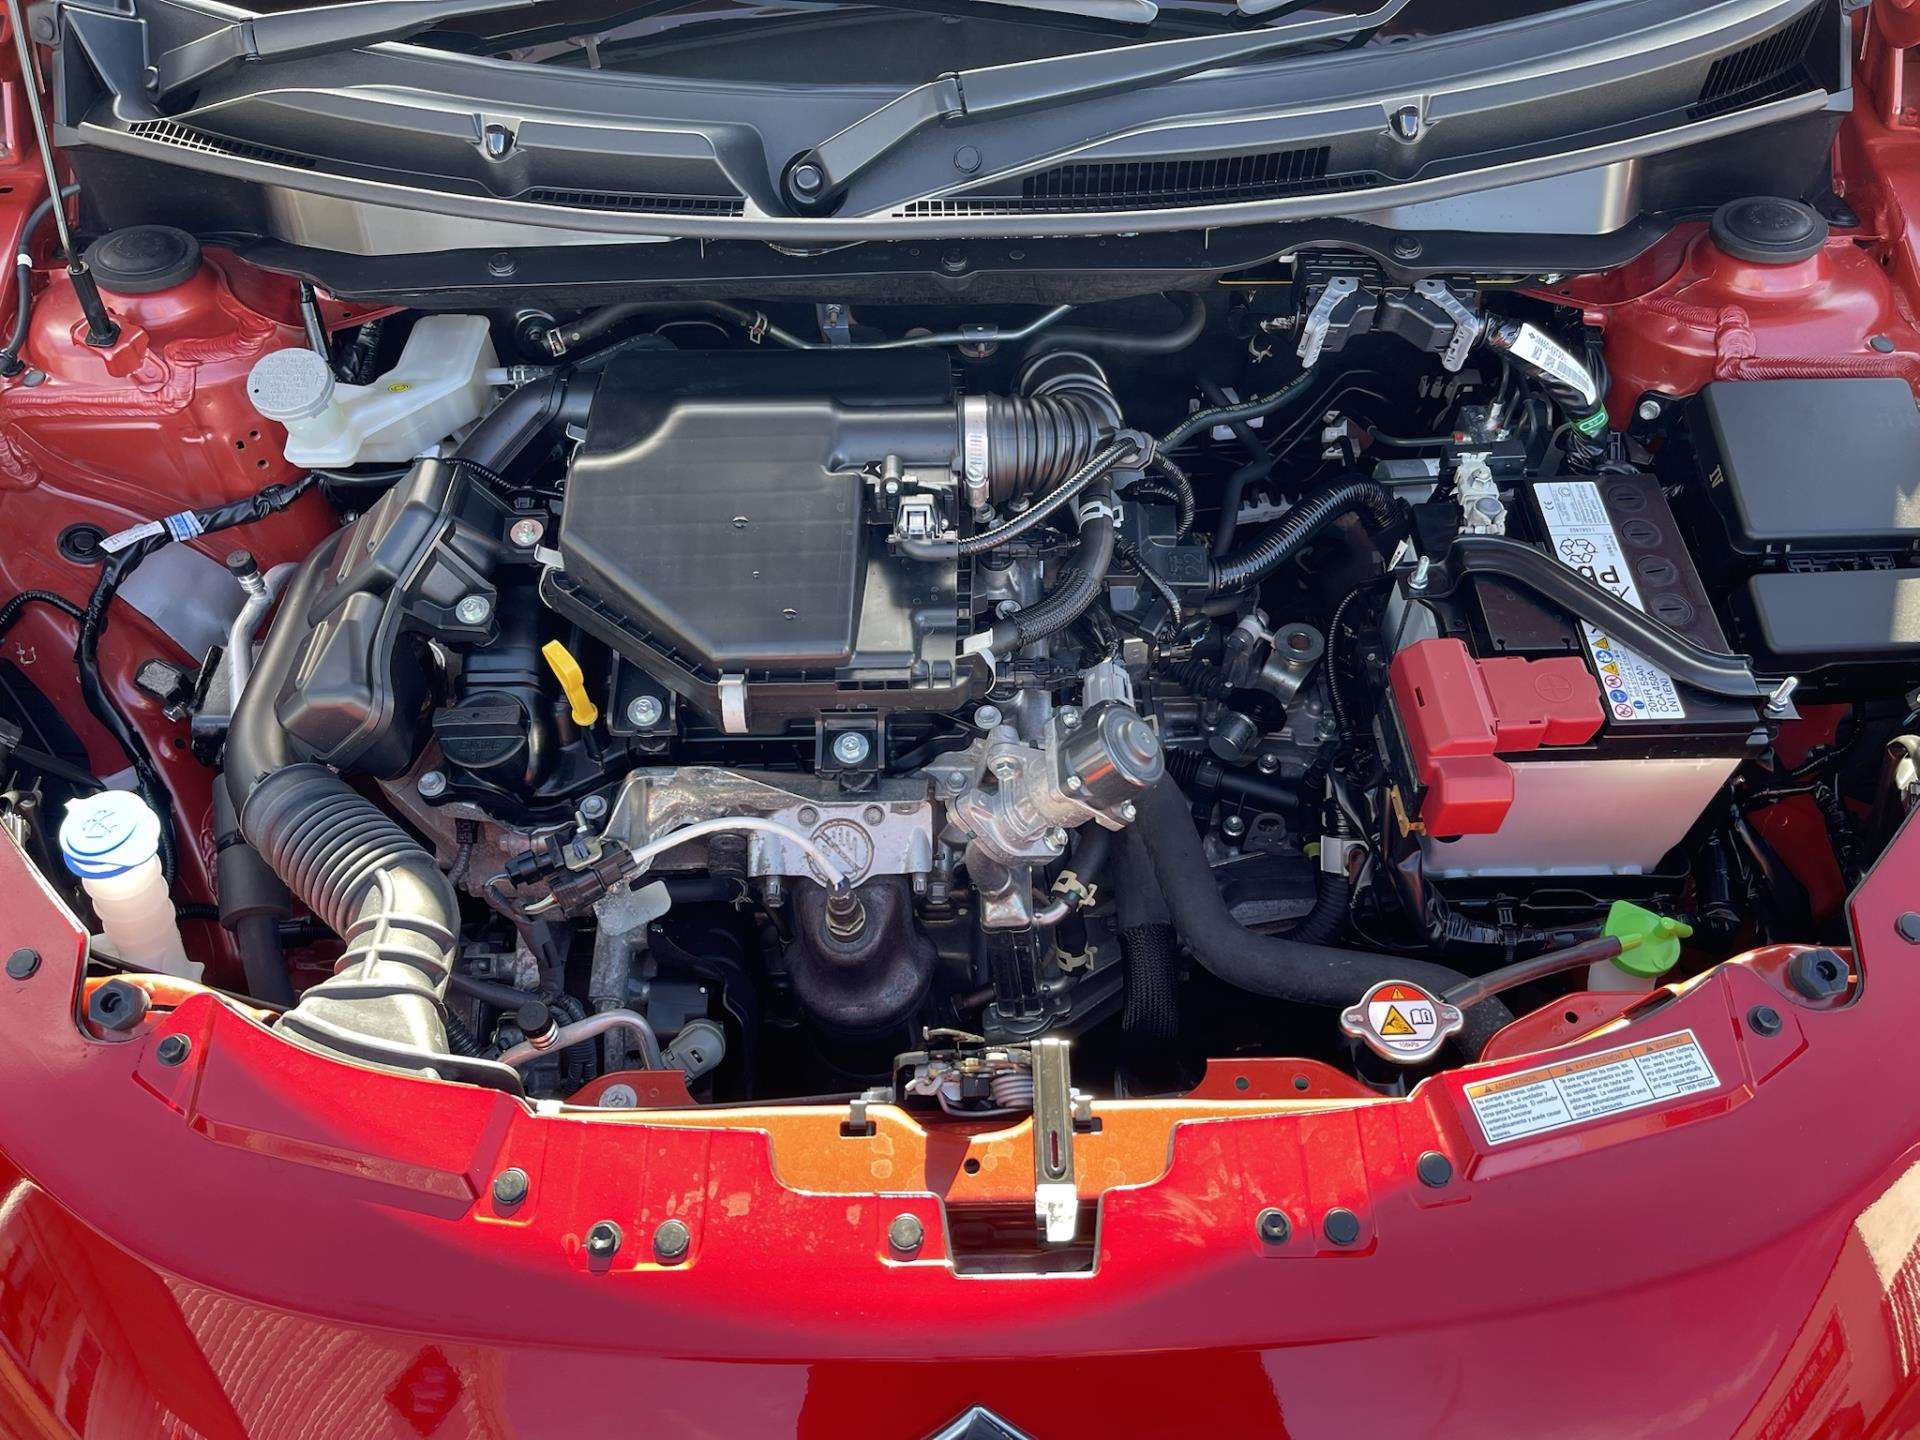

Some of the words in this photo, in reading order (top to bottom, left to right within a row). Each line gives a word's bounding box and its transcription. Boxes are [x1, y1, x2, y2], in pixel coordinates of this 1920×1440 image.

[1636, 665, 1650, 686] 55Ah
[1648, 670, 1660, 691] 450A
[1643, 689, 1659, 712] 20HR
[1656, 693, 1669, 712] CCA
